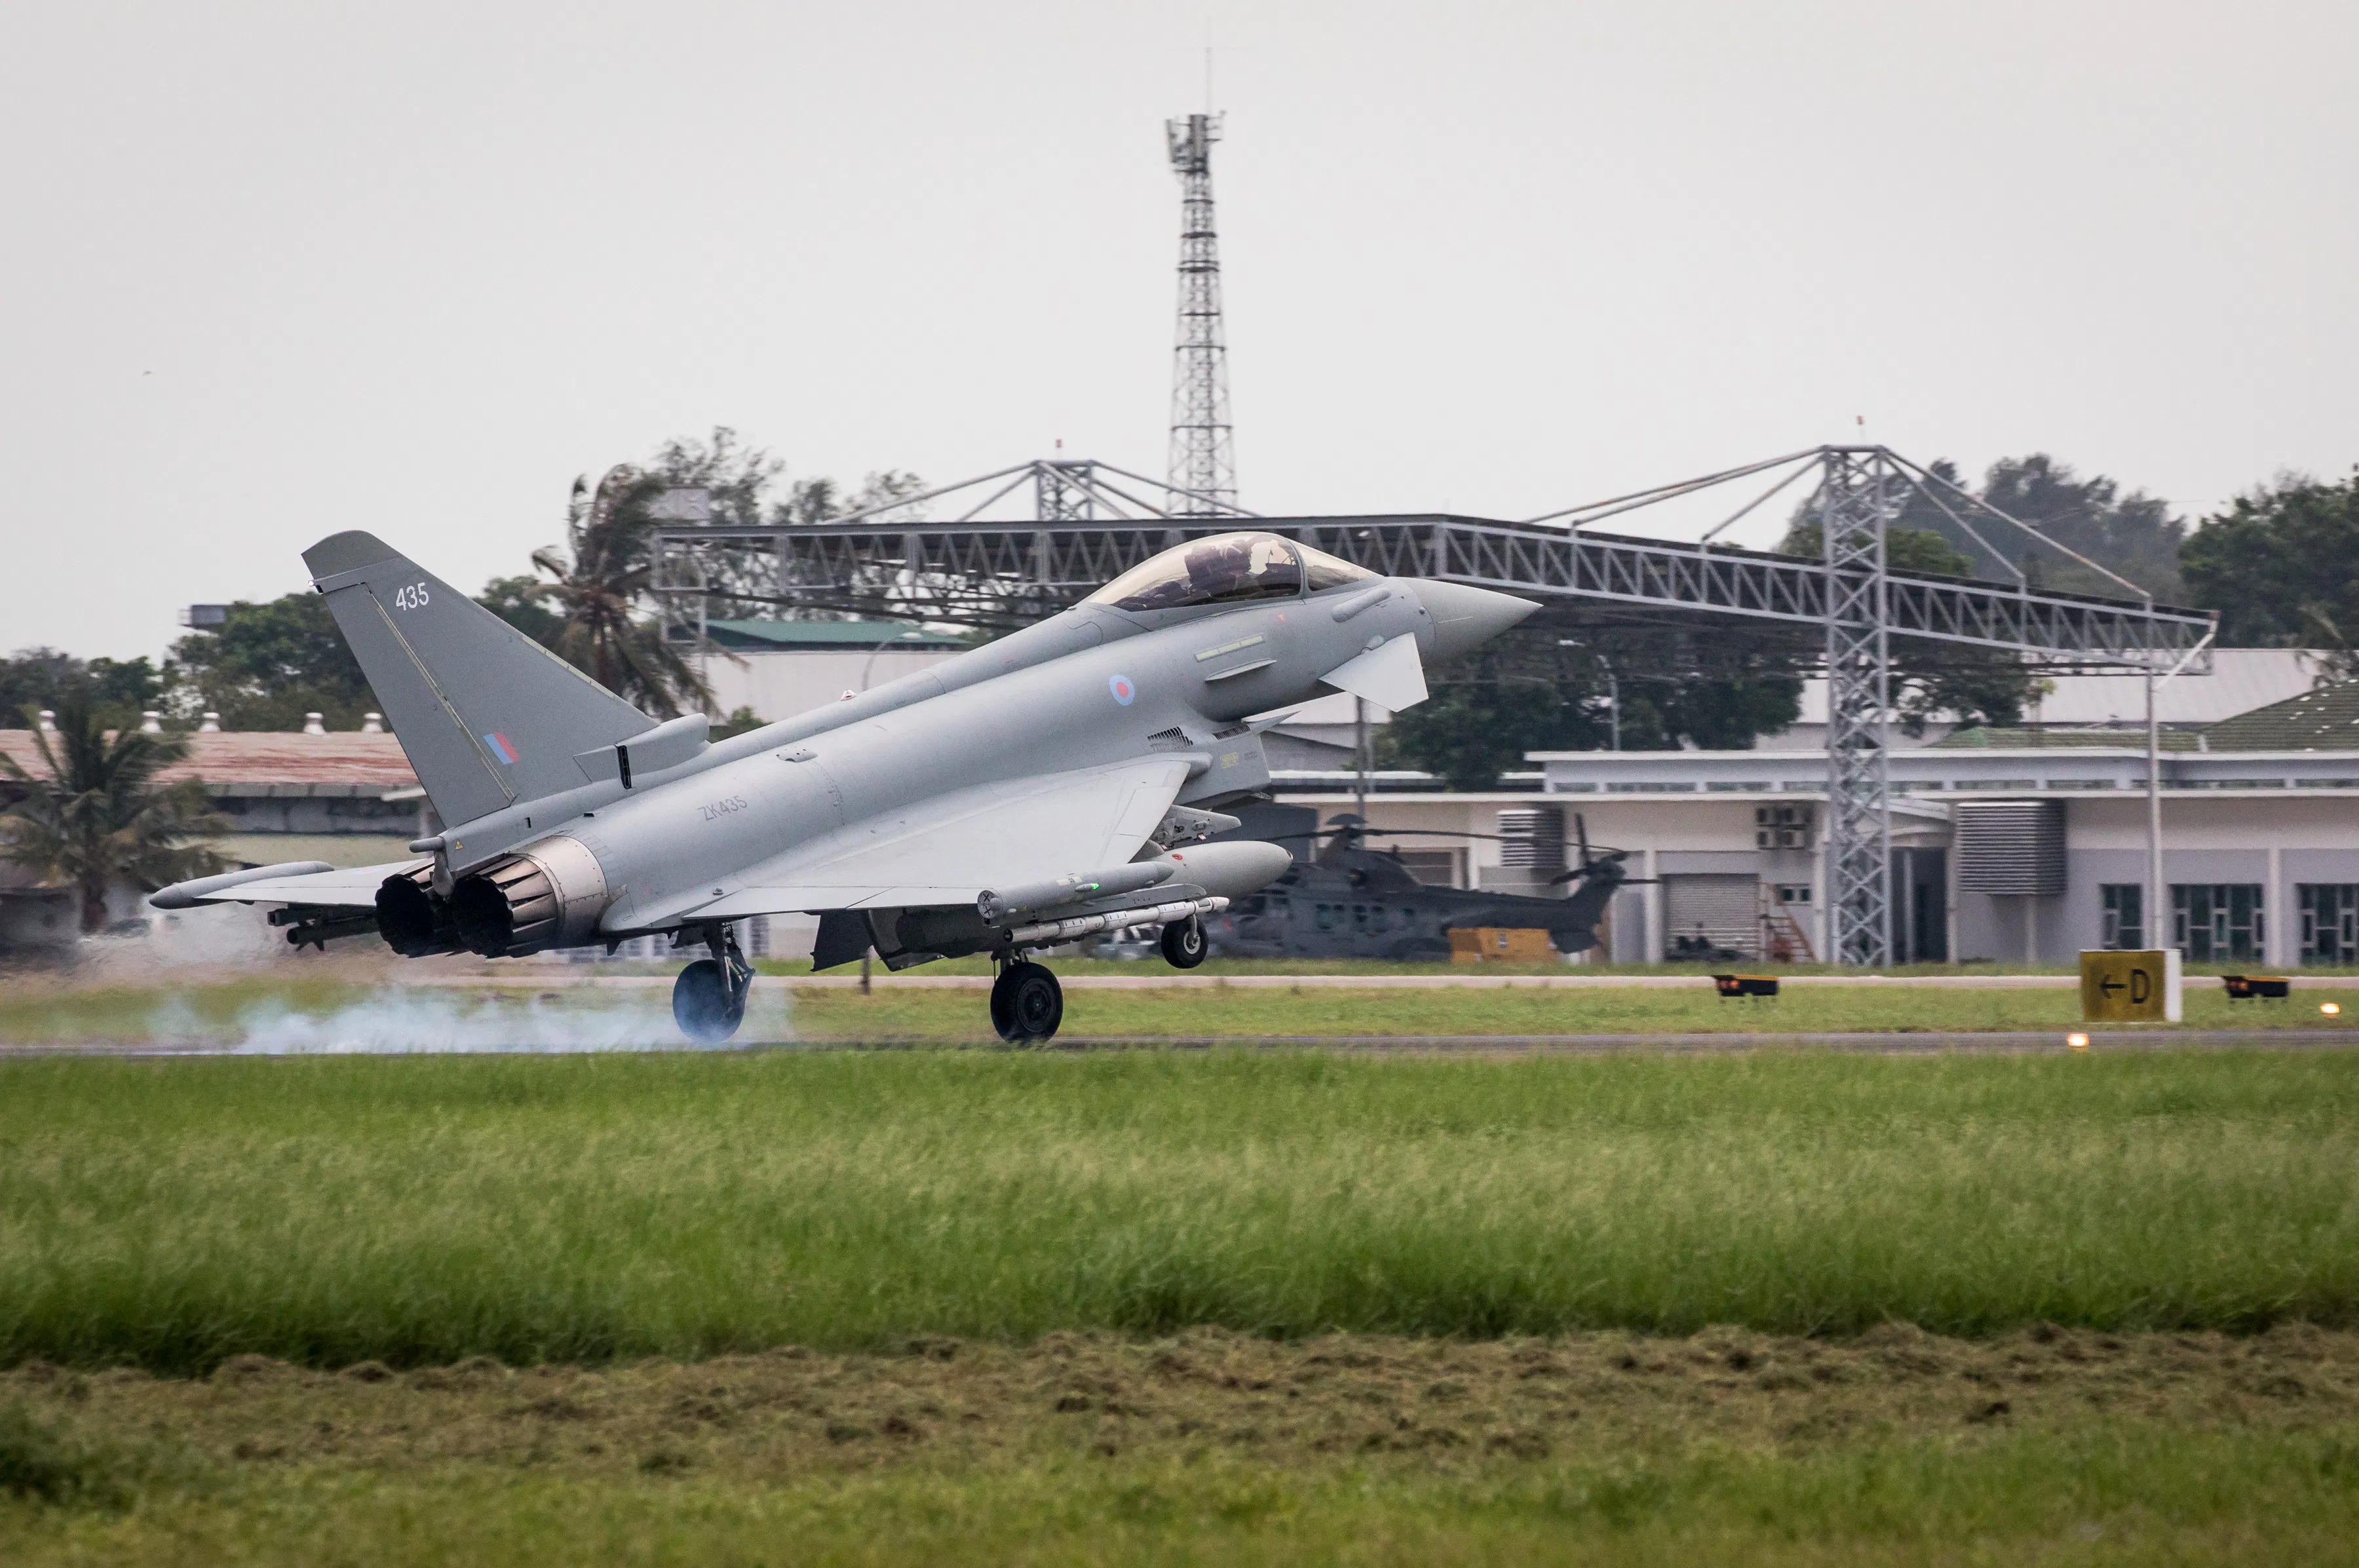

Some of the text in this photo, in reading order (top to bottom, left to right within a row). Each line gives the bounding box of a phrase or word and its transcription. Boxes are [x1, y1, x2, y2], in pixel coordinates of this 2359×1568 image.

[396, 582, 429, 611] 435
[697, 795, 748, 822] ZK435
[2132, 969, 2150, 1004] D
